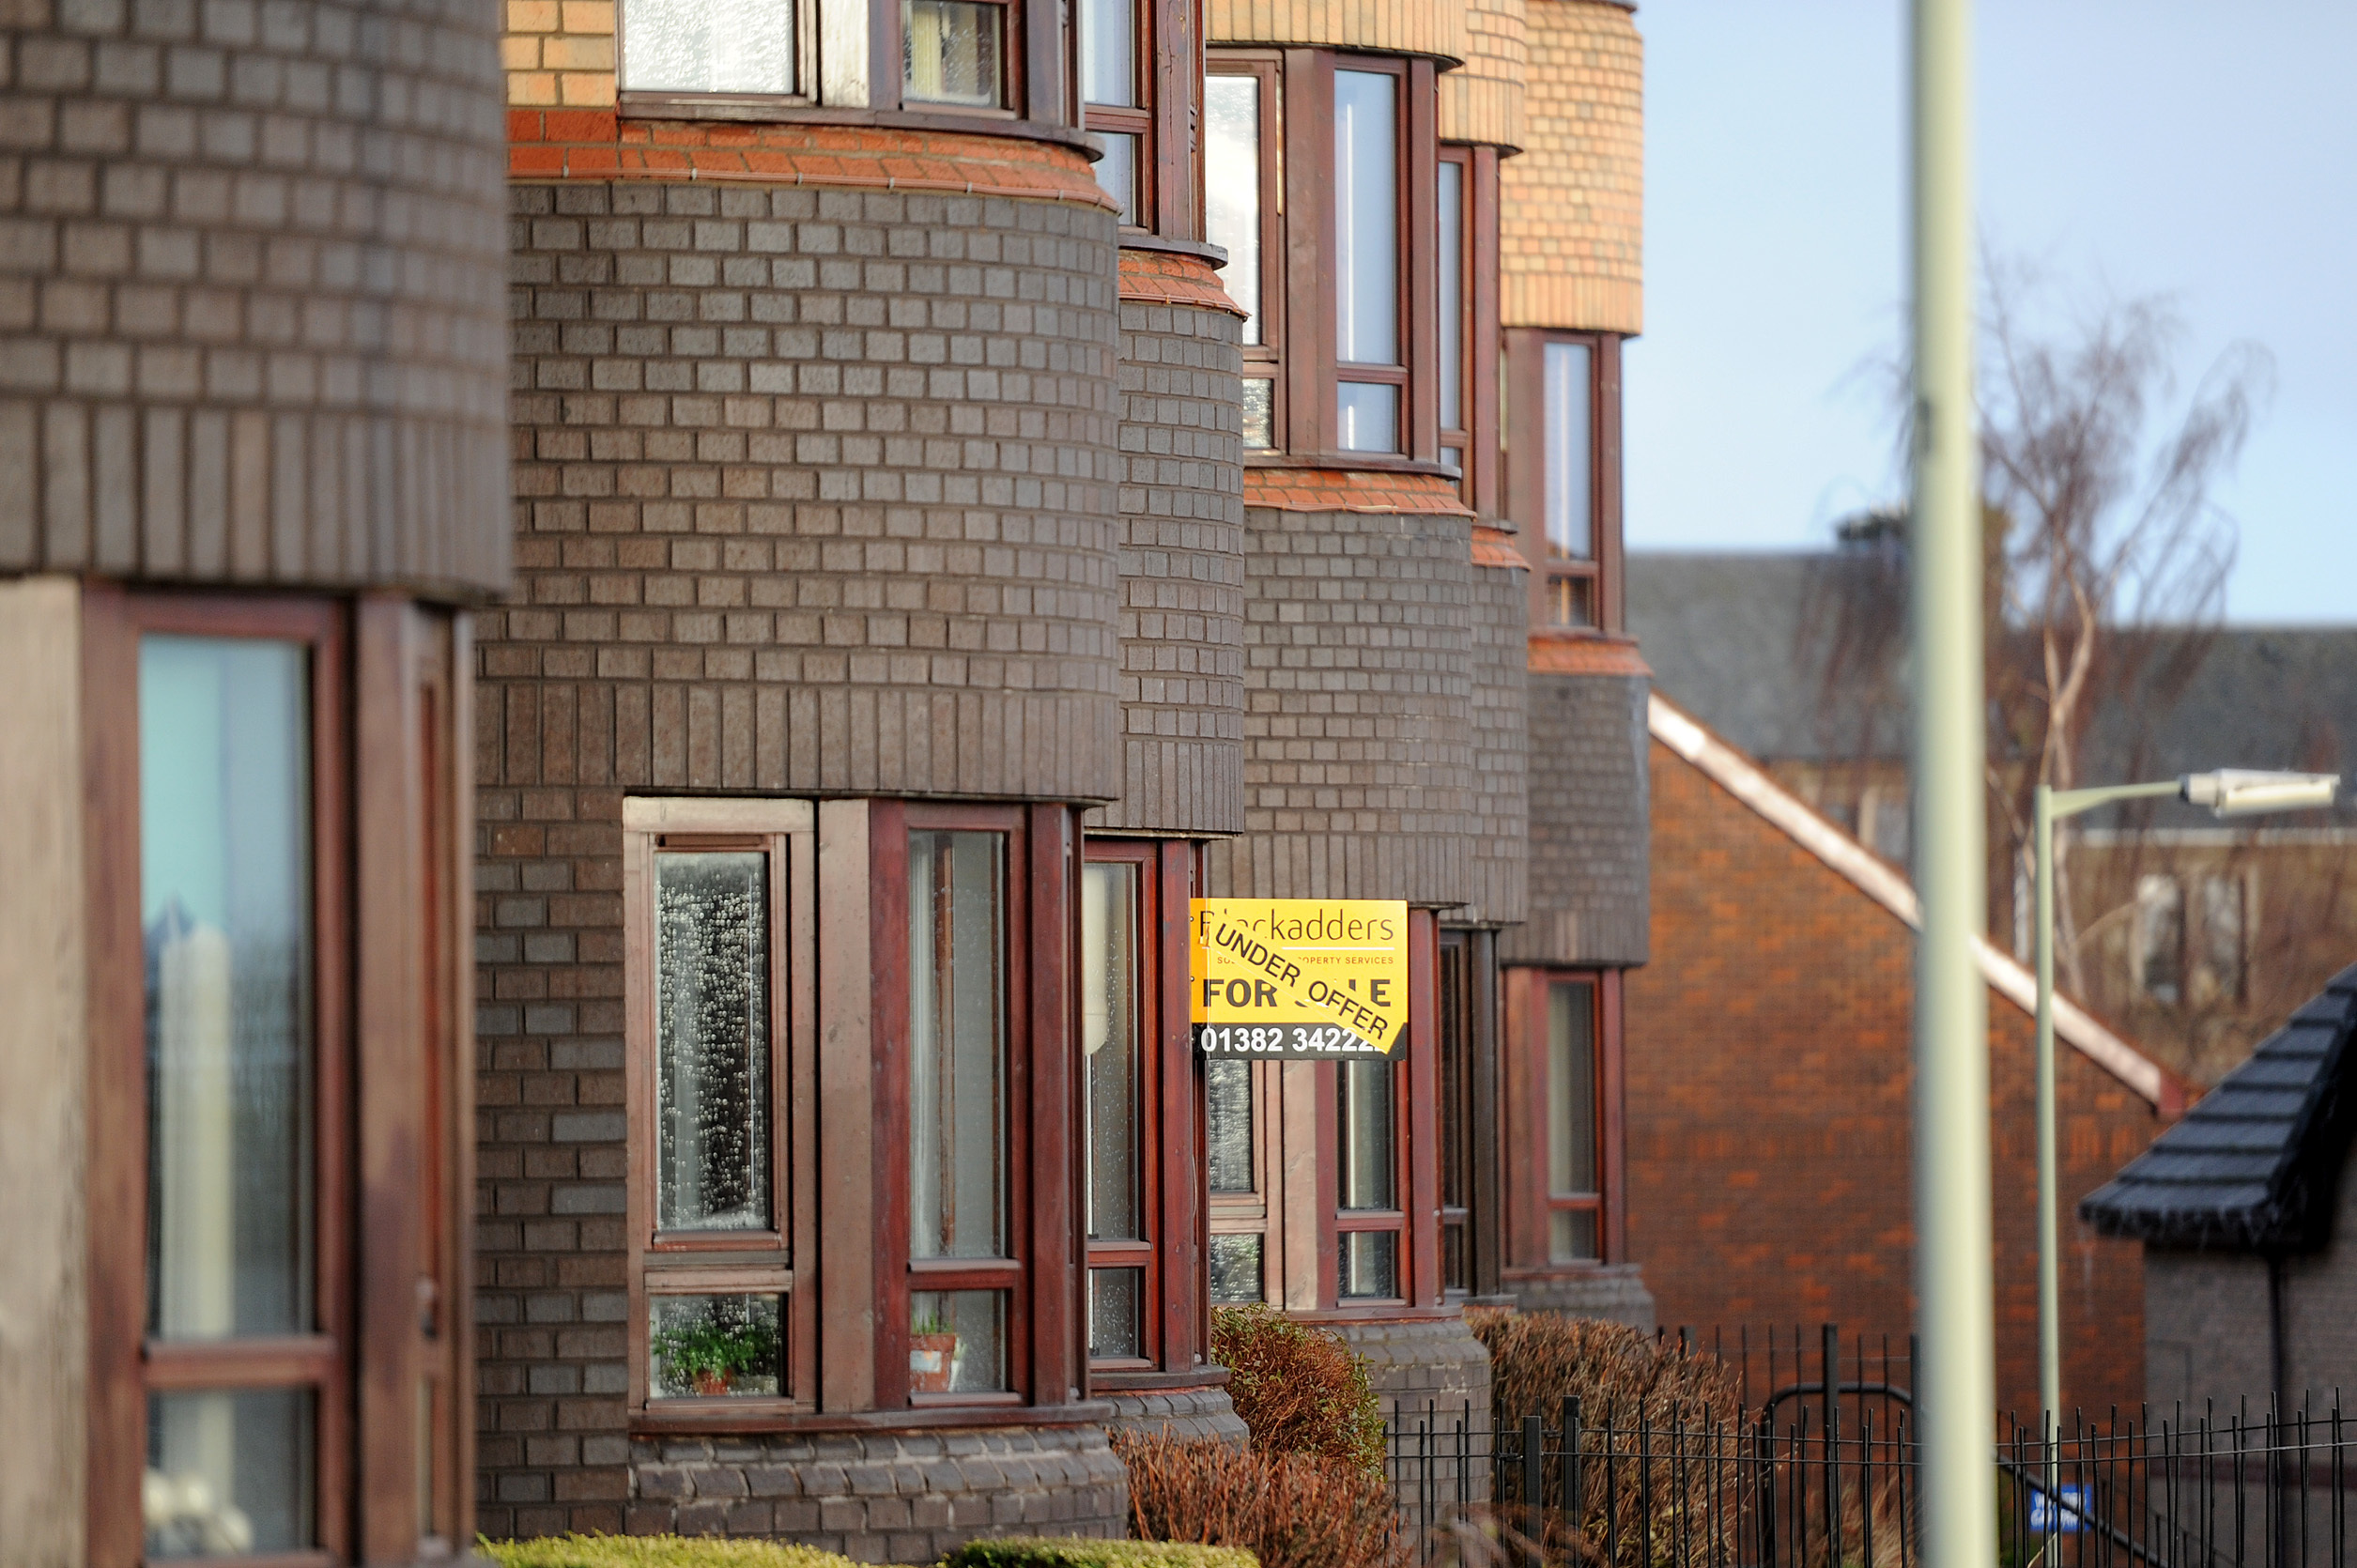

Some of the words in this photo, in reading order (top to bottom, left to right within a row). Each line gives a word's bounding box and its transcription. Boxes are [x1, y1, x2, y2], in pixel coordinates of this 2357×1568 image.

[1345, 956, 1394, 964] SERVICES
[1202, 978, 1277, 1007] FOR
[1215, 923, 1302, 988] UNDER
[1307, 980, 1390, 1040] OFFER
[1200, 1027, 1284, 1053] 01382
[1291, 1027, 1383, 1053] 34222
